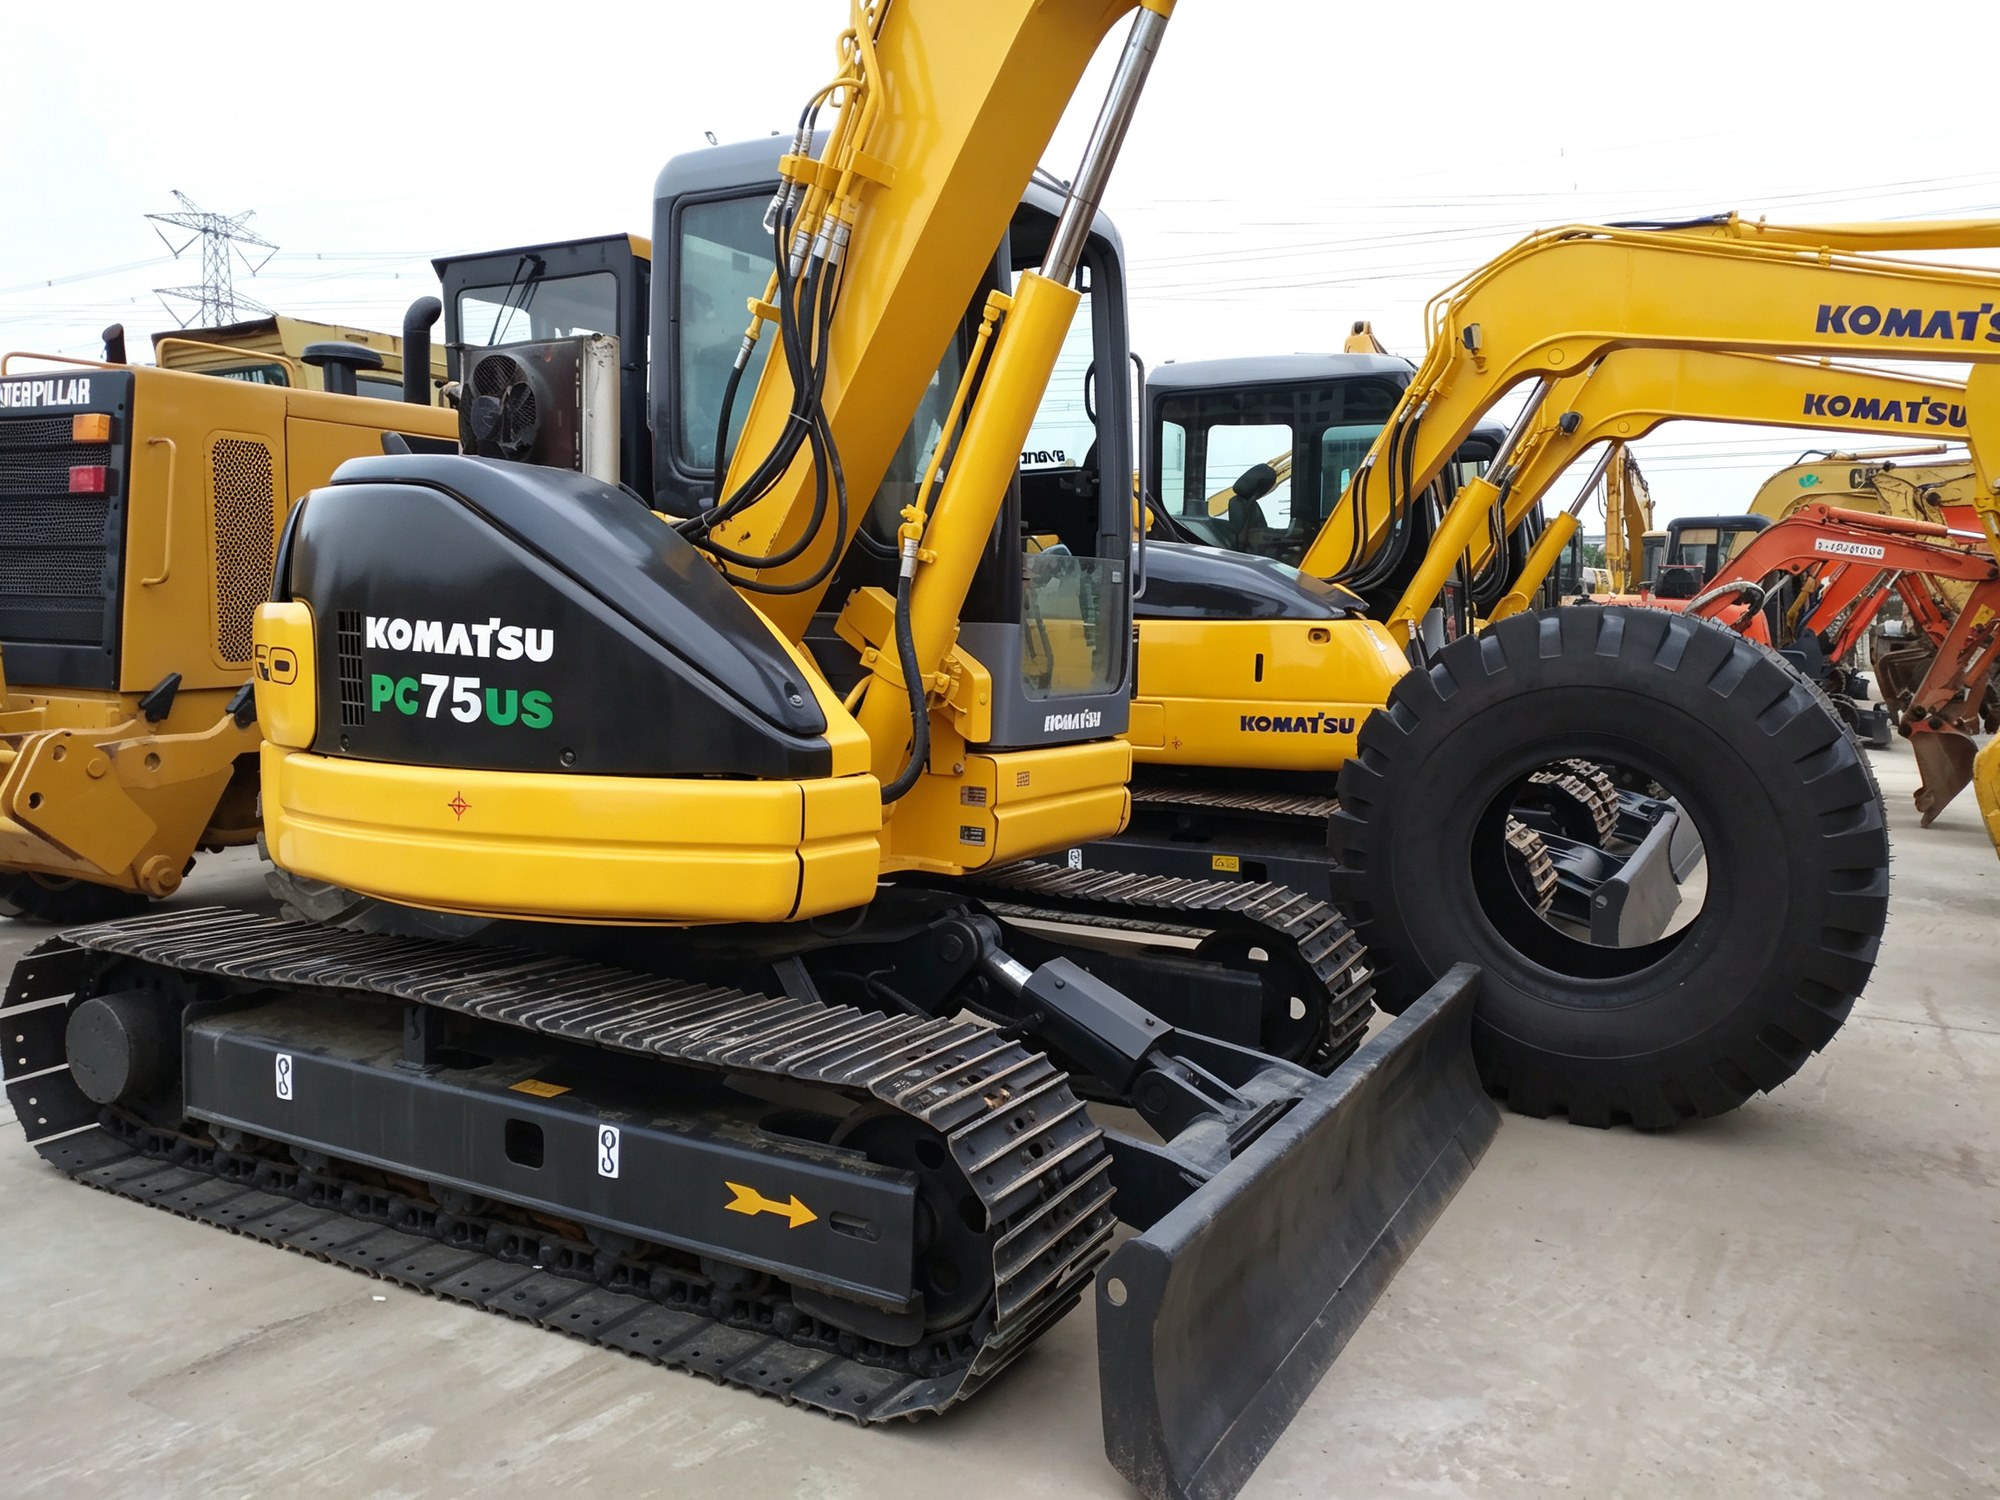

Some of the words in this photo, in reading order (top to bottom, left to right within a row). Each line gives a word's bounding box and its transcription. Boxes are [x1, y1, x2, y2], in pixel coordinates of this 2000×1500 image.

[1803, 393, 1967, 428] KOMATSU
[366, 616, 554, 663] KOMATSU
[371, 673, 554, 729] PC75US
[1240, 712, 1355, 734] KOMATSU
